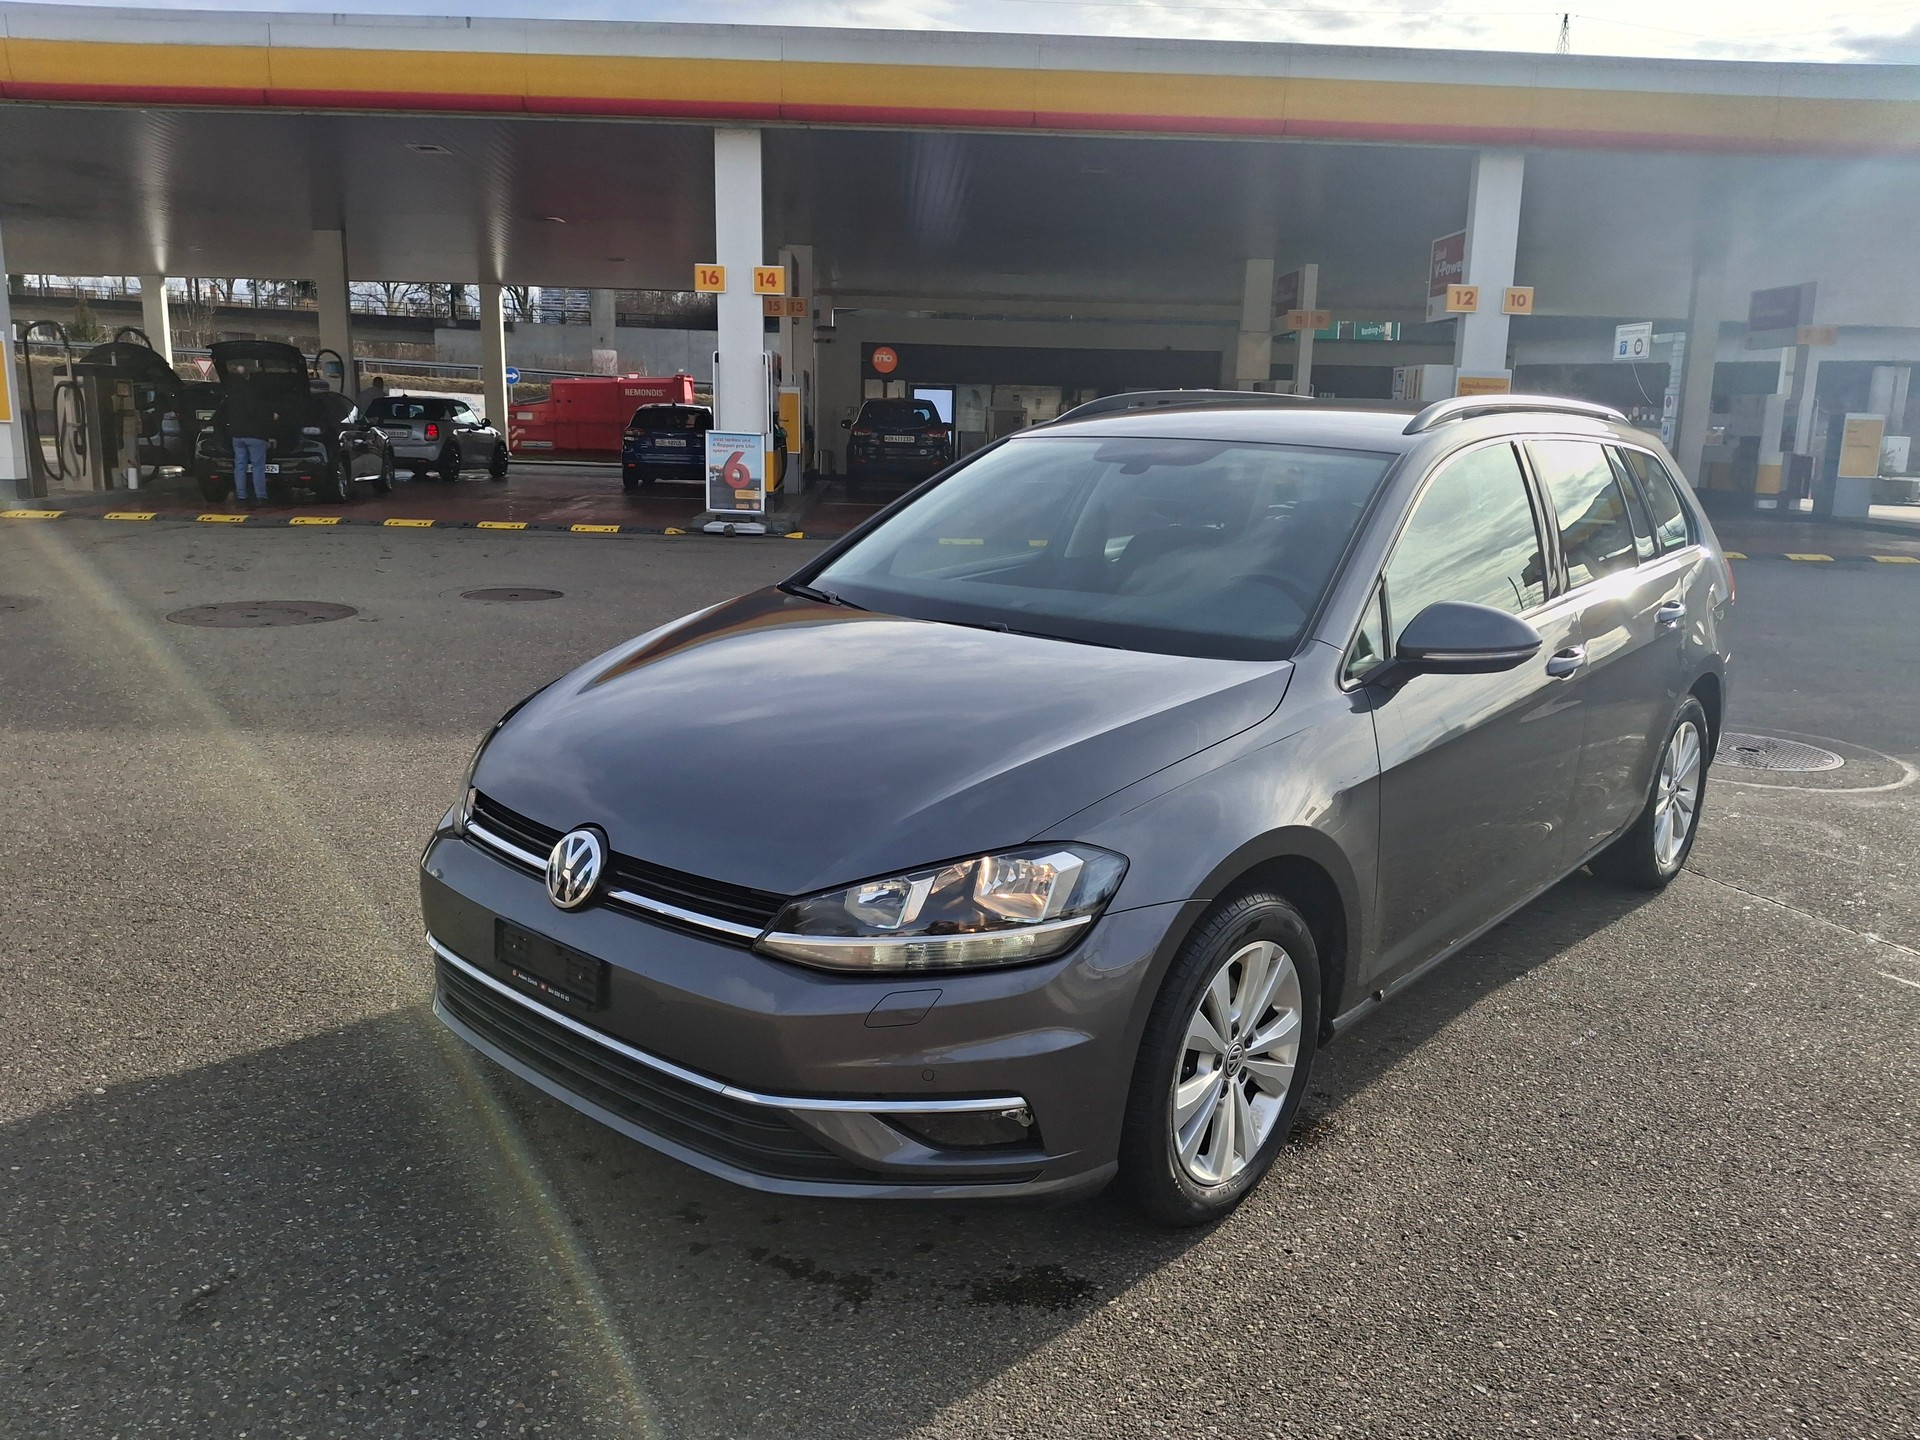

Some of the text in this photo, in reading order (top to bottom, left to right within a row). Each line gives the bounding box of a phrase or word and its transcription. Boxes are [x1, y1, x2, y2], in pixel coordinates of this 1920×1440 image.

[1434, 260, 1464, 279] V-Powe
[700, 270, 720, 285] 16
[757, 272, 777, 288] 14
[1455, 291, 1474, 305] 12
[1510, 294, 1527, 307] 10
[767, 301, 780, 312] 15
[790, 301, 804, 312] 13
[874, 352, 893, 363] mio
[624, 388, 665, 397] REMONDIS
[723, 451, 751, 489] 6
